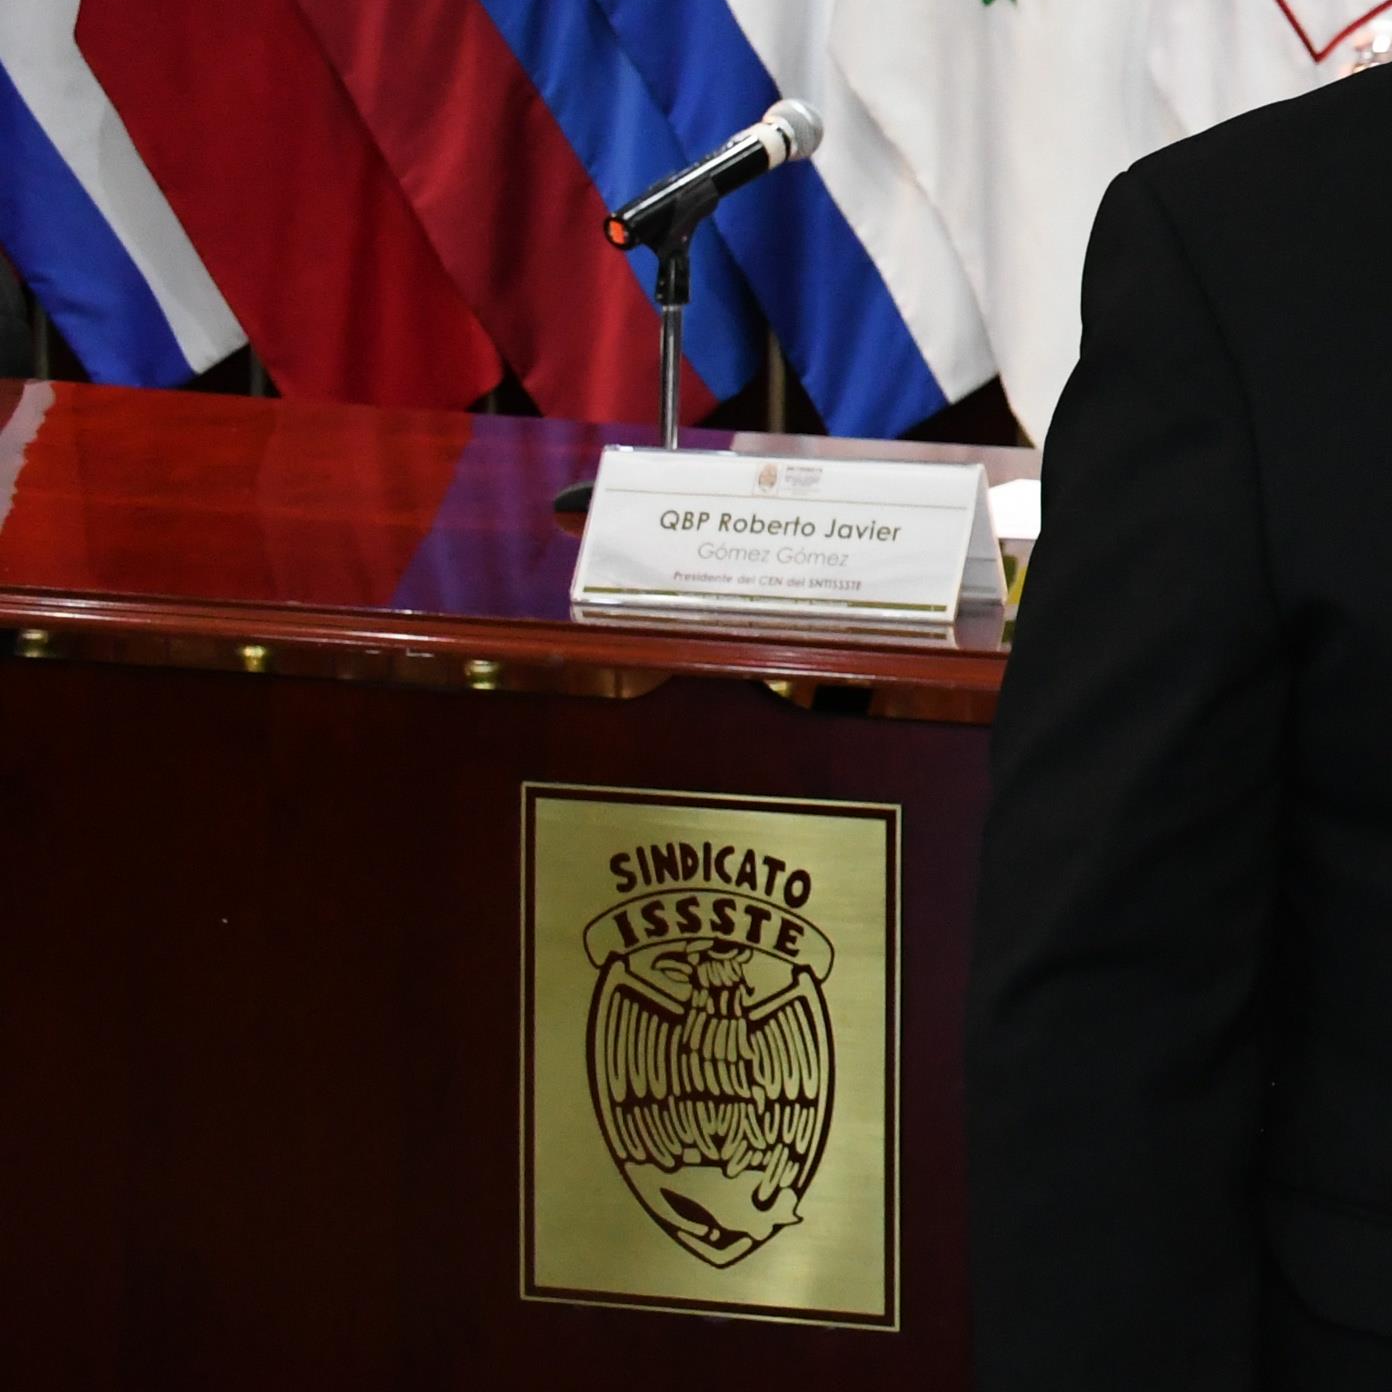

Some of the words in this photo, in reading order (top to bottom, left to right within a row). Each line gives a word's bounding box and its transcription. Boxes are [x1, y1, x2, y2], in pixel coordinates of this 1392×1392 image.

[659, 510, 710, 531] QBP
[718, 512, 815, 537] Roberto
[824, 518, 901, 542] Javier
[697, 541, 770, 562] Gómez
[776, 546, 850, 568] Gómez
[673, 570, 733, 584] Presidente
[737, 575, 756, 585] del
[759, 576, 783, 587] CEN
[787, 578, 806, 589] del
[609, 840, 813, 908] SINDICATO
[614, 895, 806, 959] ISSSTE
